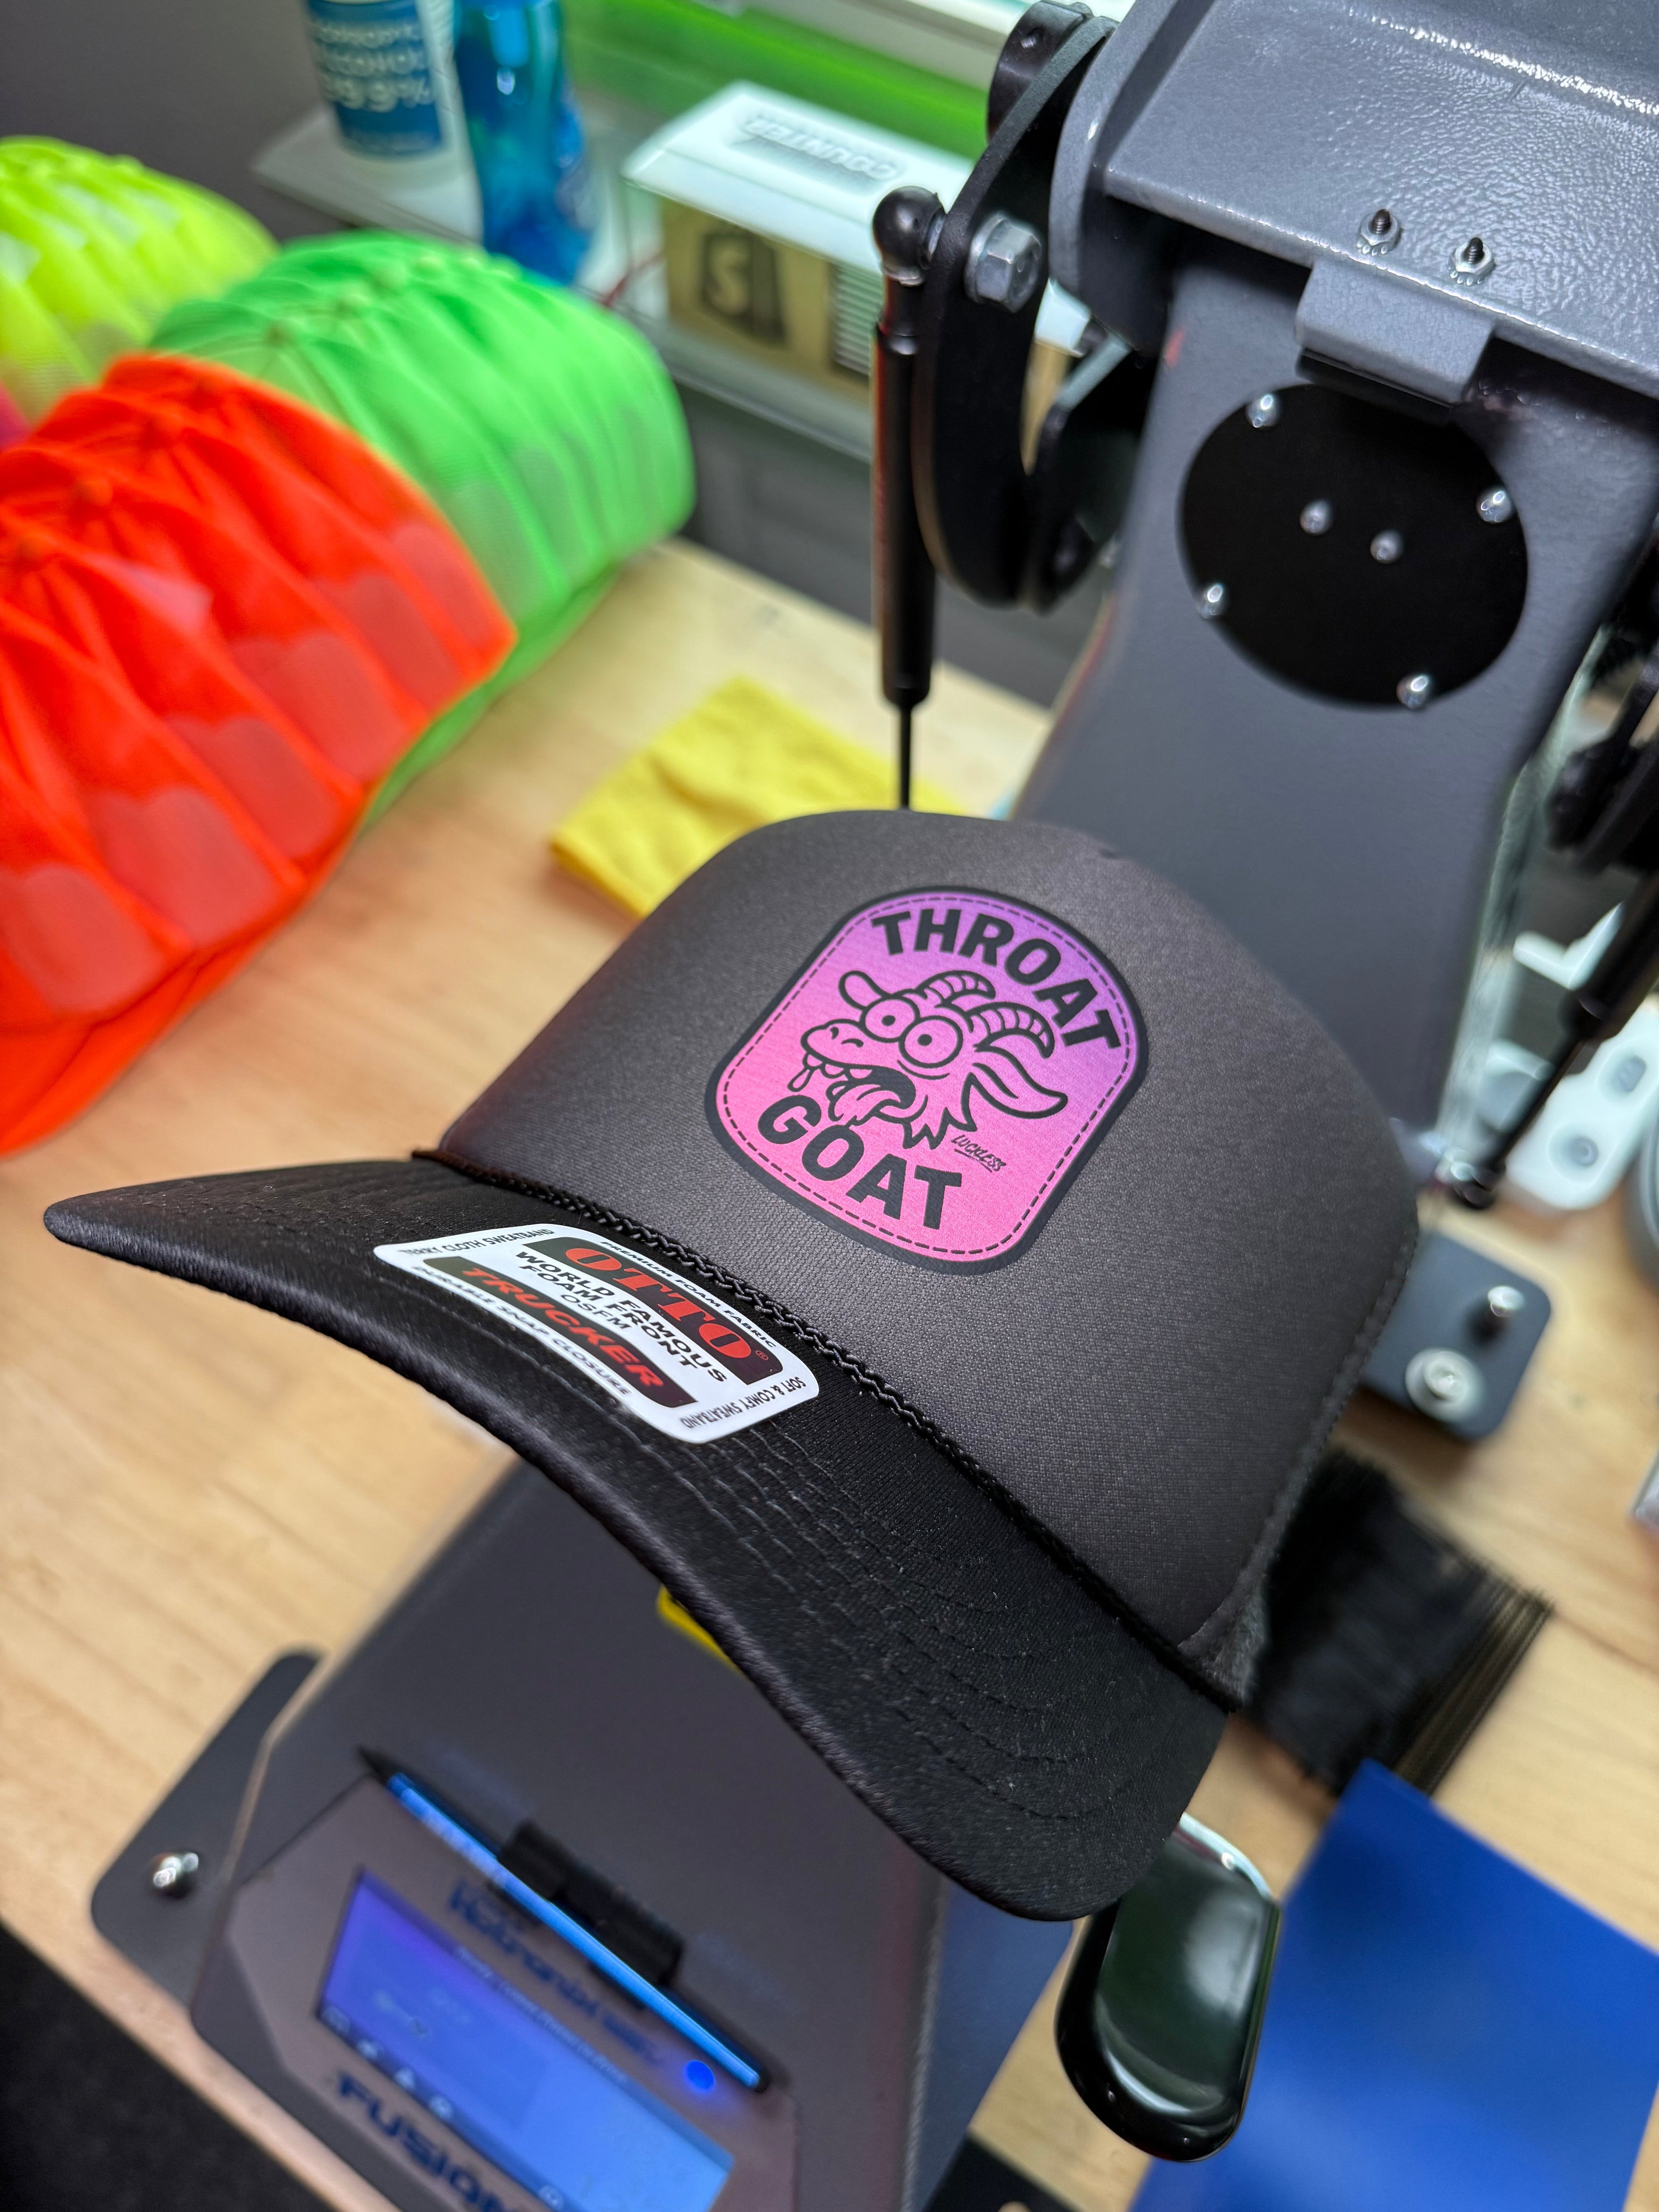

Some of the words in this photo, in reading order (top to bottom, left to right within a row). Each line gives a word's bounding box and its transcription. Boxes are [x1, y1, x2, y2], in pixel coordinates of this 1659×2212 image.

[871, 908, 1121, 1050] THROAT
[757, 1094, 963, 1230] GOAT
[951, 1134, 1007, 1172] LUCKLESS
[442, 1239, 487, 1252] CLOTH
[482, 1229, 555, 1245] SWEATBAND
[515, 1251, 615, 1296] WORLD
[619, 1299, 728, 1382] FAMOUS
[518, 1265, 604, 1301] FOAM
[605, 1303, 698, 1369] FRONT
[561, 1294, 632, 1329] OSFM
[600, 1241, 673, 1278] PREMIUM
[674, 1279, 722, 1307] FOAM
[723, 1309, 777, 1348] FABRIC
[461, 1268, 664, 1387] TRUCKER
[552, 1338, 632, 1395] CLOSURE
[770, 1385, 785, 1395] &
[781, 1376, 807, 1392] SOFT
[679, 1402, 744, 1429] SWEATBAND
[739, 1389, 776, 1410] COMFY
